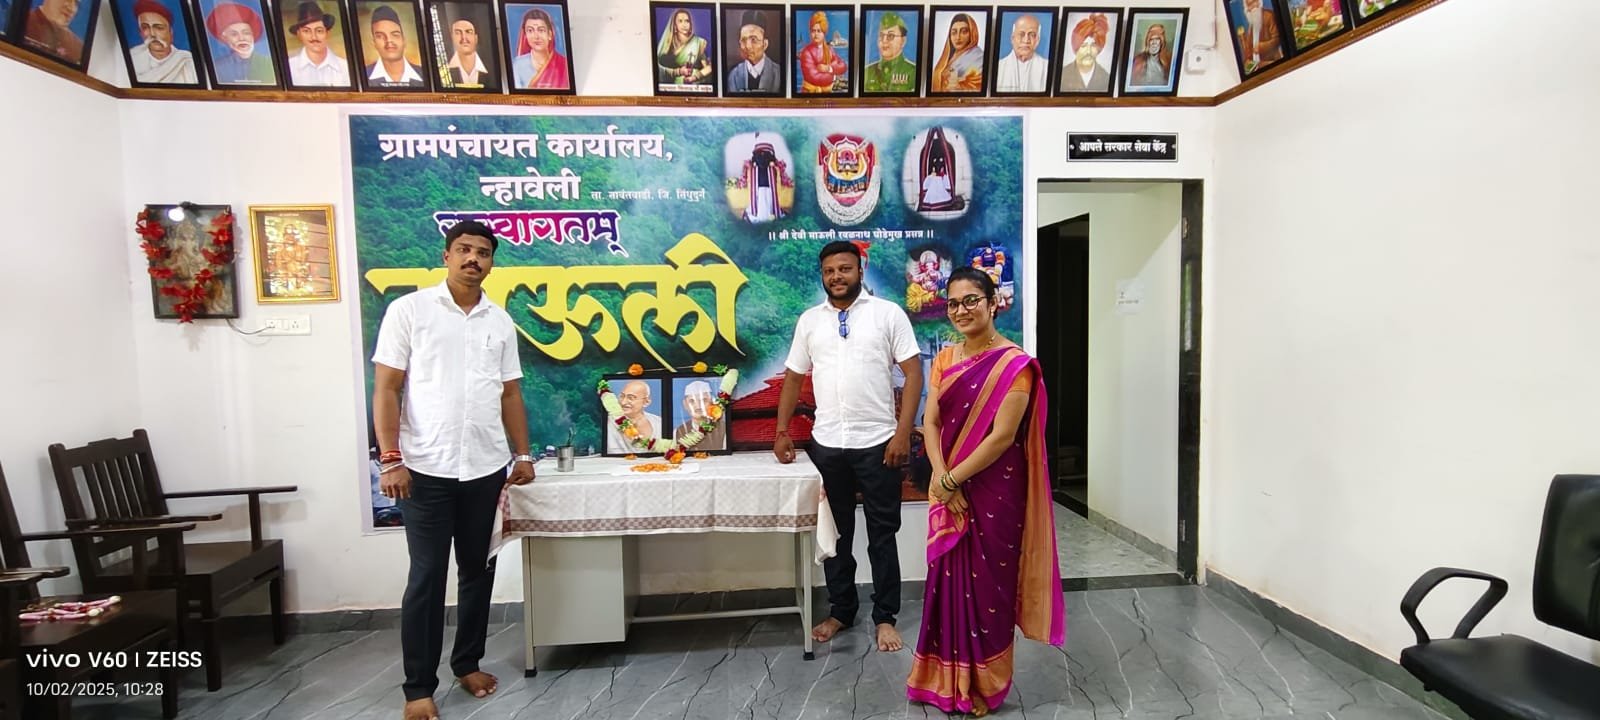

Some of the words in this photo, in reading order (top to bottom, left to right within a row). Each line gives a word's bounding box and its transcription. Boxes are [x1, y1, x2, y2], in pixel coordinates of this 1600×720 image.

[378, 125, 538, 161] ग्रामपंचायत
[545, 124, 673, 162] कार्यालय,
[1079, 139, 1103, 152] आपले
[1104, 142, 1133, 152] सरकार
[1134, 139, 1151, 152] सेवा
[480, 166, 581, 206] न्हावेली
[791, 228, 806, 240] देवी
